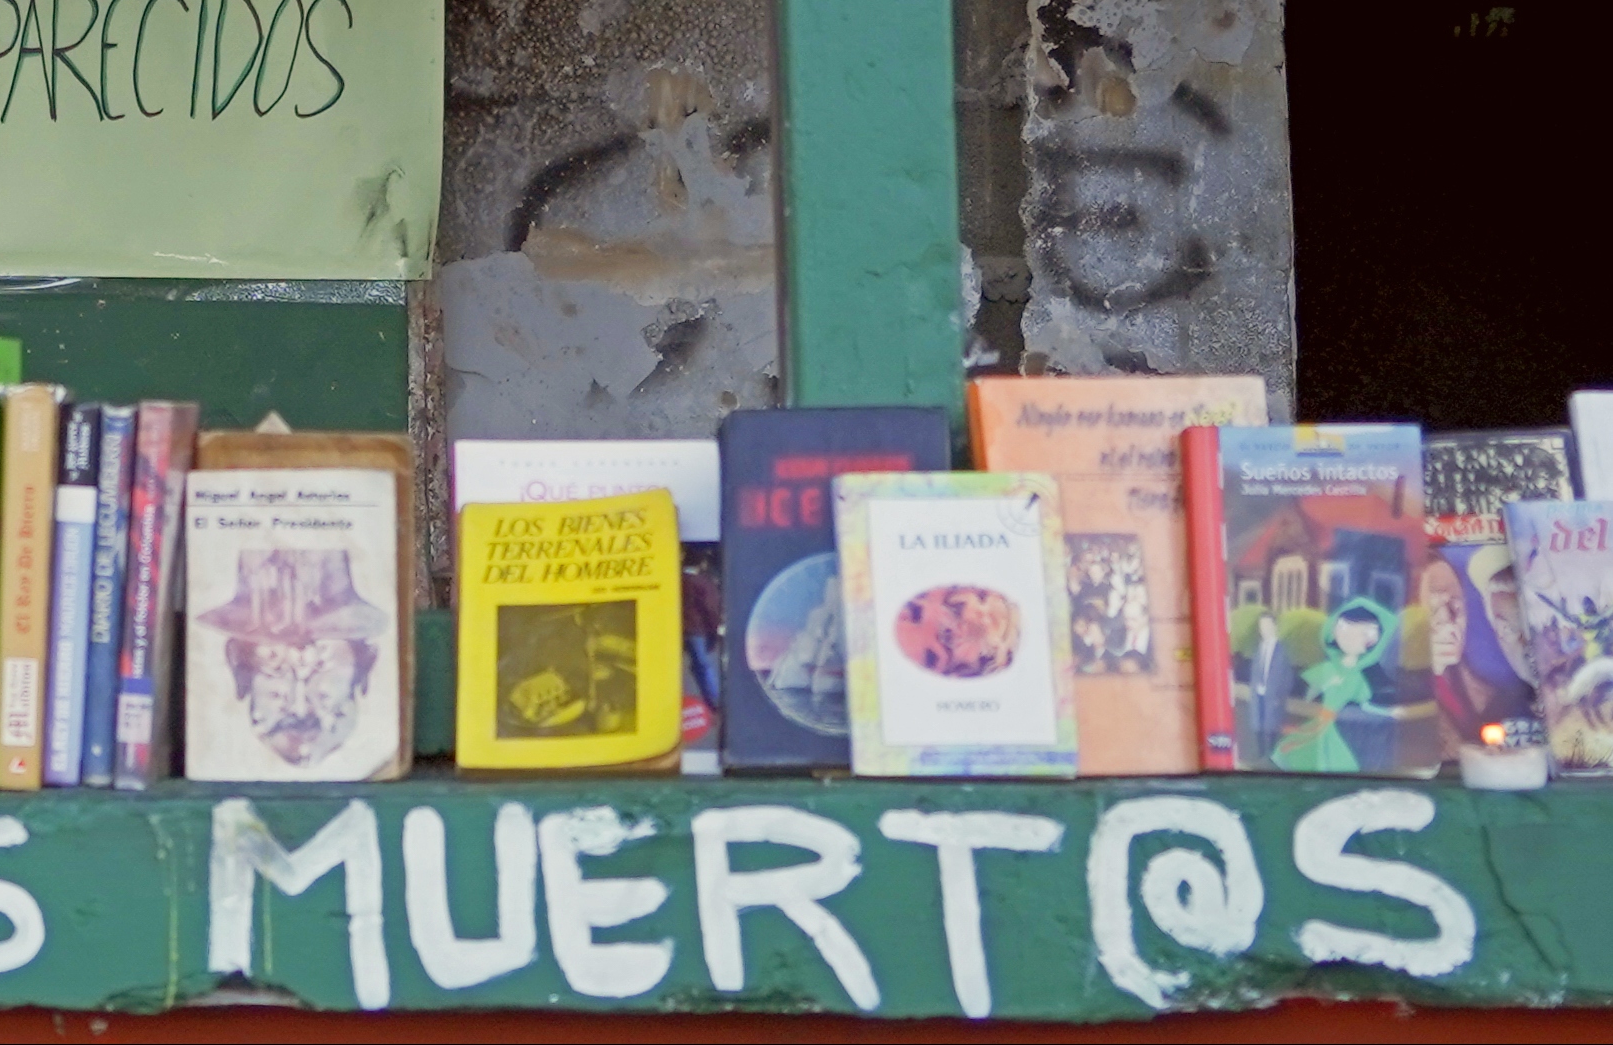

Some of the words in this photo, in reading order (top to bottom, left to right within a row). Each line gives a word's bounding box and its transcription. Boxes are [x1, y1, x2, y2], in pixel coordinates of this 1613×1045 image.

[1241, 461, 1312, 481] Sueños
[1317, 462, 1399, 481] intactos
[96, 434, 121, 547] LECUMBERRI
[493, 517, 544, 538] LOS
[558, 508, 647, 535] BIENES
[1549, 517, 1609, 552] del
[487, 532, 654, 562] TERRENALES
[898, 534, 926, 550] LA
[934, 533, 1010, 549] ILIADA
[94, 549, 115, 577] DE
[482, 563, 534, 584] DEL
[542, 556, 655, 583] HOMBRE
[91, 577, 113, 644] DIARIO
[54, 640, 74, 697] HIERRO
[207, 788, 1476, 1020] MUERT@S
